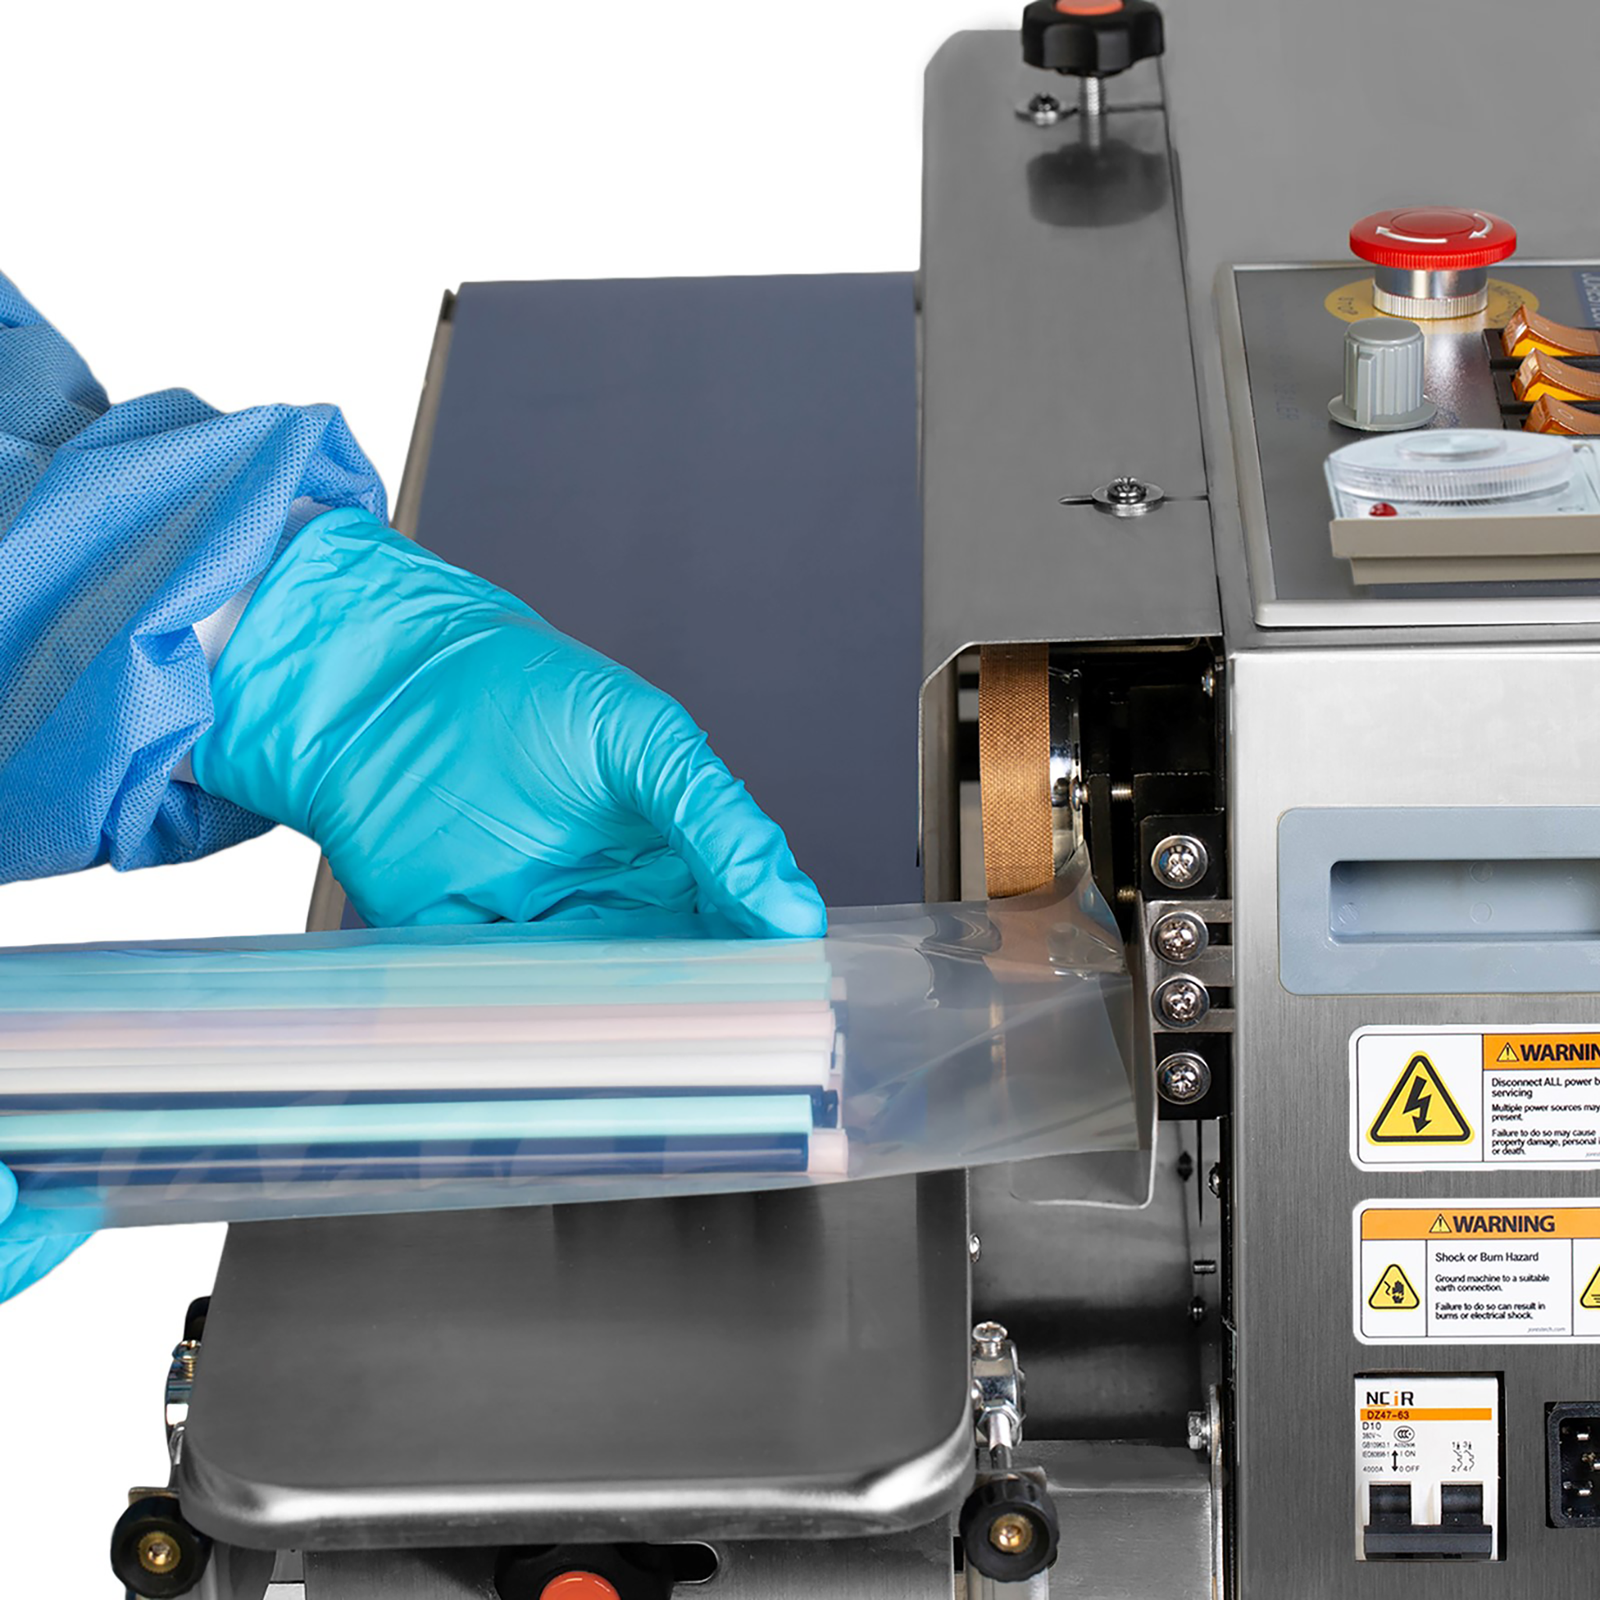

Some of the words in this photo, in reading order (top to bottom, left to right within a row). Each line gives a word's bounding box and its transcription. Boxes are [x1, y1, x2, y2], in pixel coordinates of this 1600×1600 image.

[1520, 1043, 1600, 1062] WARNIN
[1491, 1077, 1542, 1088] Disconnect
[1544, 1077, 1563, 1087] ALL
[1564, 1078, 1593, 1089] power
[1491, 1088, 1533, 1099] servicing
[1491, 1104, 1523, 1114] Multiple
[1524, 1104, 1549, 1114] power
[1550, 1104, 1582, 1113] sources
[1491, 1113, 1523, 1123] present.
[1491, 1129, 1519, 1138] Failure
[1520, 1129, 1529, 1137] to
[1530, 1129, 1541, 1137] do
[1554, 1130, 1571, 1139] may
[1572, 1129, 1596, 1137] cause
[1491, 1138, 1525, 1148] property
[1527, 1138, 1561, 1148] damage,
[1562, 1138, 1597, 1147] personal
[1501, 1146, 1526, 1155] death.
[1453, 1215, 1555, 1233] WARNING
[1435, 1252, 1466, 1262] Shock
[1467, 1254, 1478, 1262] or
[1480, 1252, 1504, 1262] Burn
[1505, 1252, 1539, 1262] Hazard
[1435, 1274, 1466, 1283] Ground
[1467, 1274, 1501, 1282] machine
[1502, 1274, 1511, 1282] to
[1519, 1273, 1550, 1282] suitable
[1435, 1284, 1456, 1292] earth
[1457, 1284, 1503, 1292] connection.
[1435, 1302, 1462, 1311] Failure
[1463, 1302, 1473, 1310] to
[1474, 1302, 1485, 1310] do
[1514, 1302, 1536, 1310] result
[1538, 1302, 1546, 1310] in
[1435, 1311, 1459, 1320] burns
[1470, 1311, 1506, 1320] electrical
[1507, 1311, 1533, 1319] shock.
[1367, 1411, 1410, 1420] DZ47-63
[1362, 1422, 1382, 1431] D10
[1405, 1464, 1420, 1473] OFF
